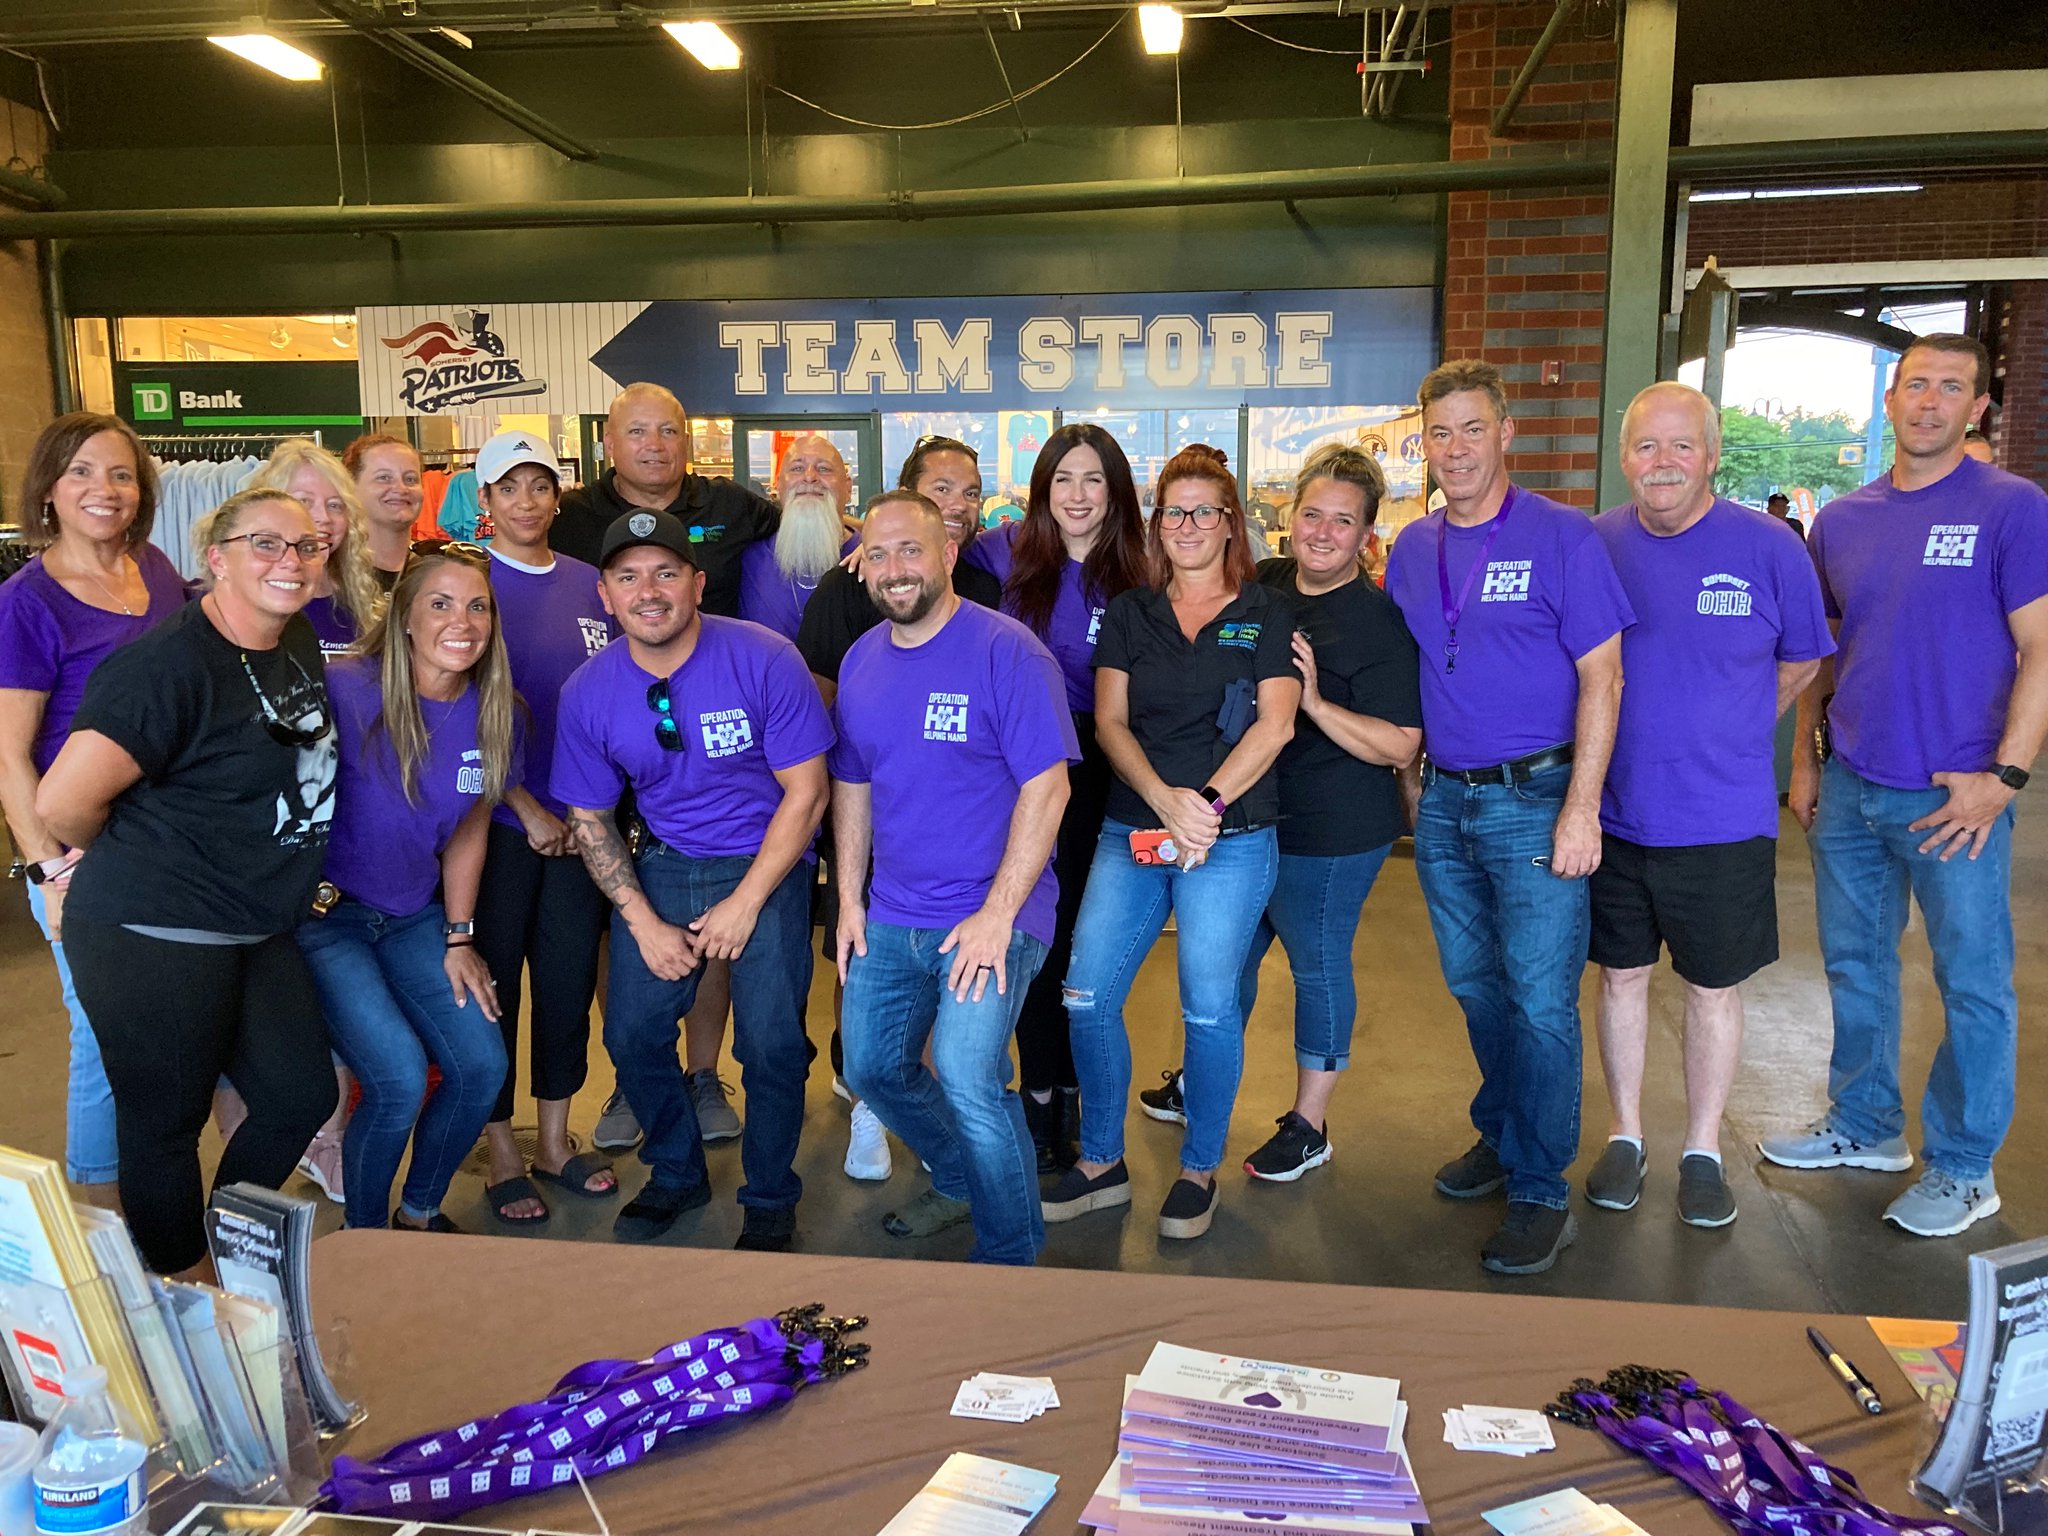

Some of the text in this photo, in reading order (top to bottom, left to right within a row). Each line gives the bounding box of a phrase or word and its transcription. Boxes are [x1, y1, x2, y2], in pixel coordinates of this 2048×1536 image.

[718, 312, 1333, 394] TEAM STORE
[430, 357, 472, 367] SOMERSET
[399, 359, 526, 409] PATRIOTS
[135, 389, 243, 413] TD Bank
[1930, 524, 1979, 535] OPERATION
[1487, 560, 1532, 571] OPERATION
[1922, 557, 1973, 567] HELPING HAND
[1701, 573, 1751, 590] SOMERSET
[1481, 593, 1528, 602] HELPING HAND
[928, 692, 969, 705] OPERATION
[700, 708, 747, 724] OPERATION
[923, 730, 967, 742] HELPING HAND
[706, 740, 753, 758] HELPING HAND
[1210, 1405, 1267, 1419] Treatment
[1184, 1410, 1320, 1436] Substance Use Disorder
[1298, 1418, 1360, 1433] Prevention
[1188, 1432, 1235, 1446] Disorder
[1238, 1441, 1260, 1449] Use
[1200, 1472, 1250, 1481] Disorder
[42, 1489, 98, 1502] KIRKLAND
[1207, 1495, 1354, 1512] Substance Use Disorder
